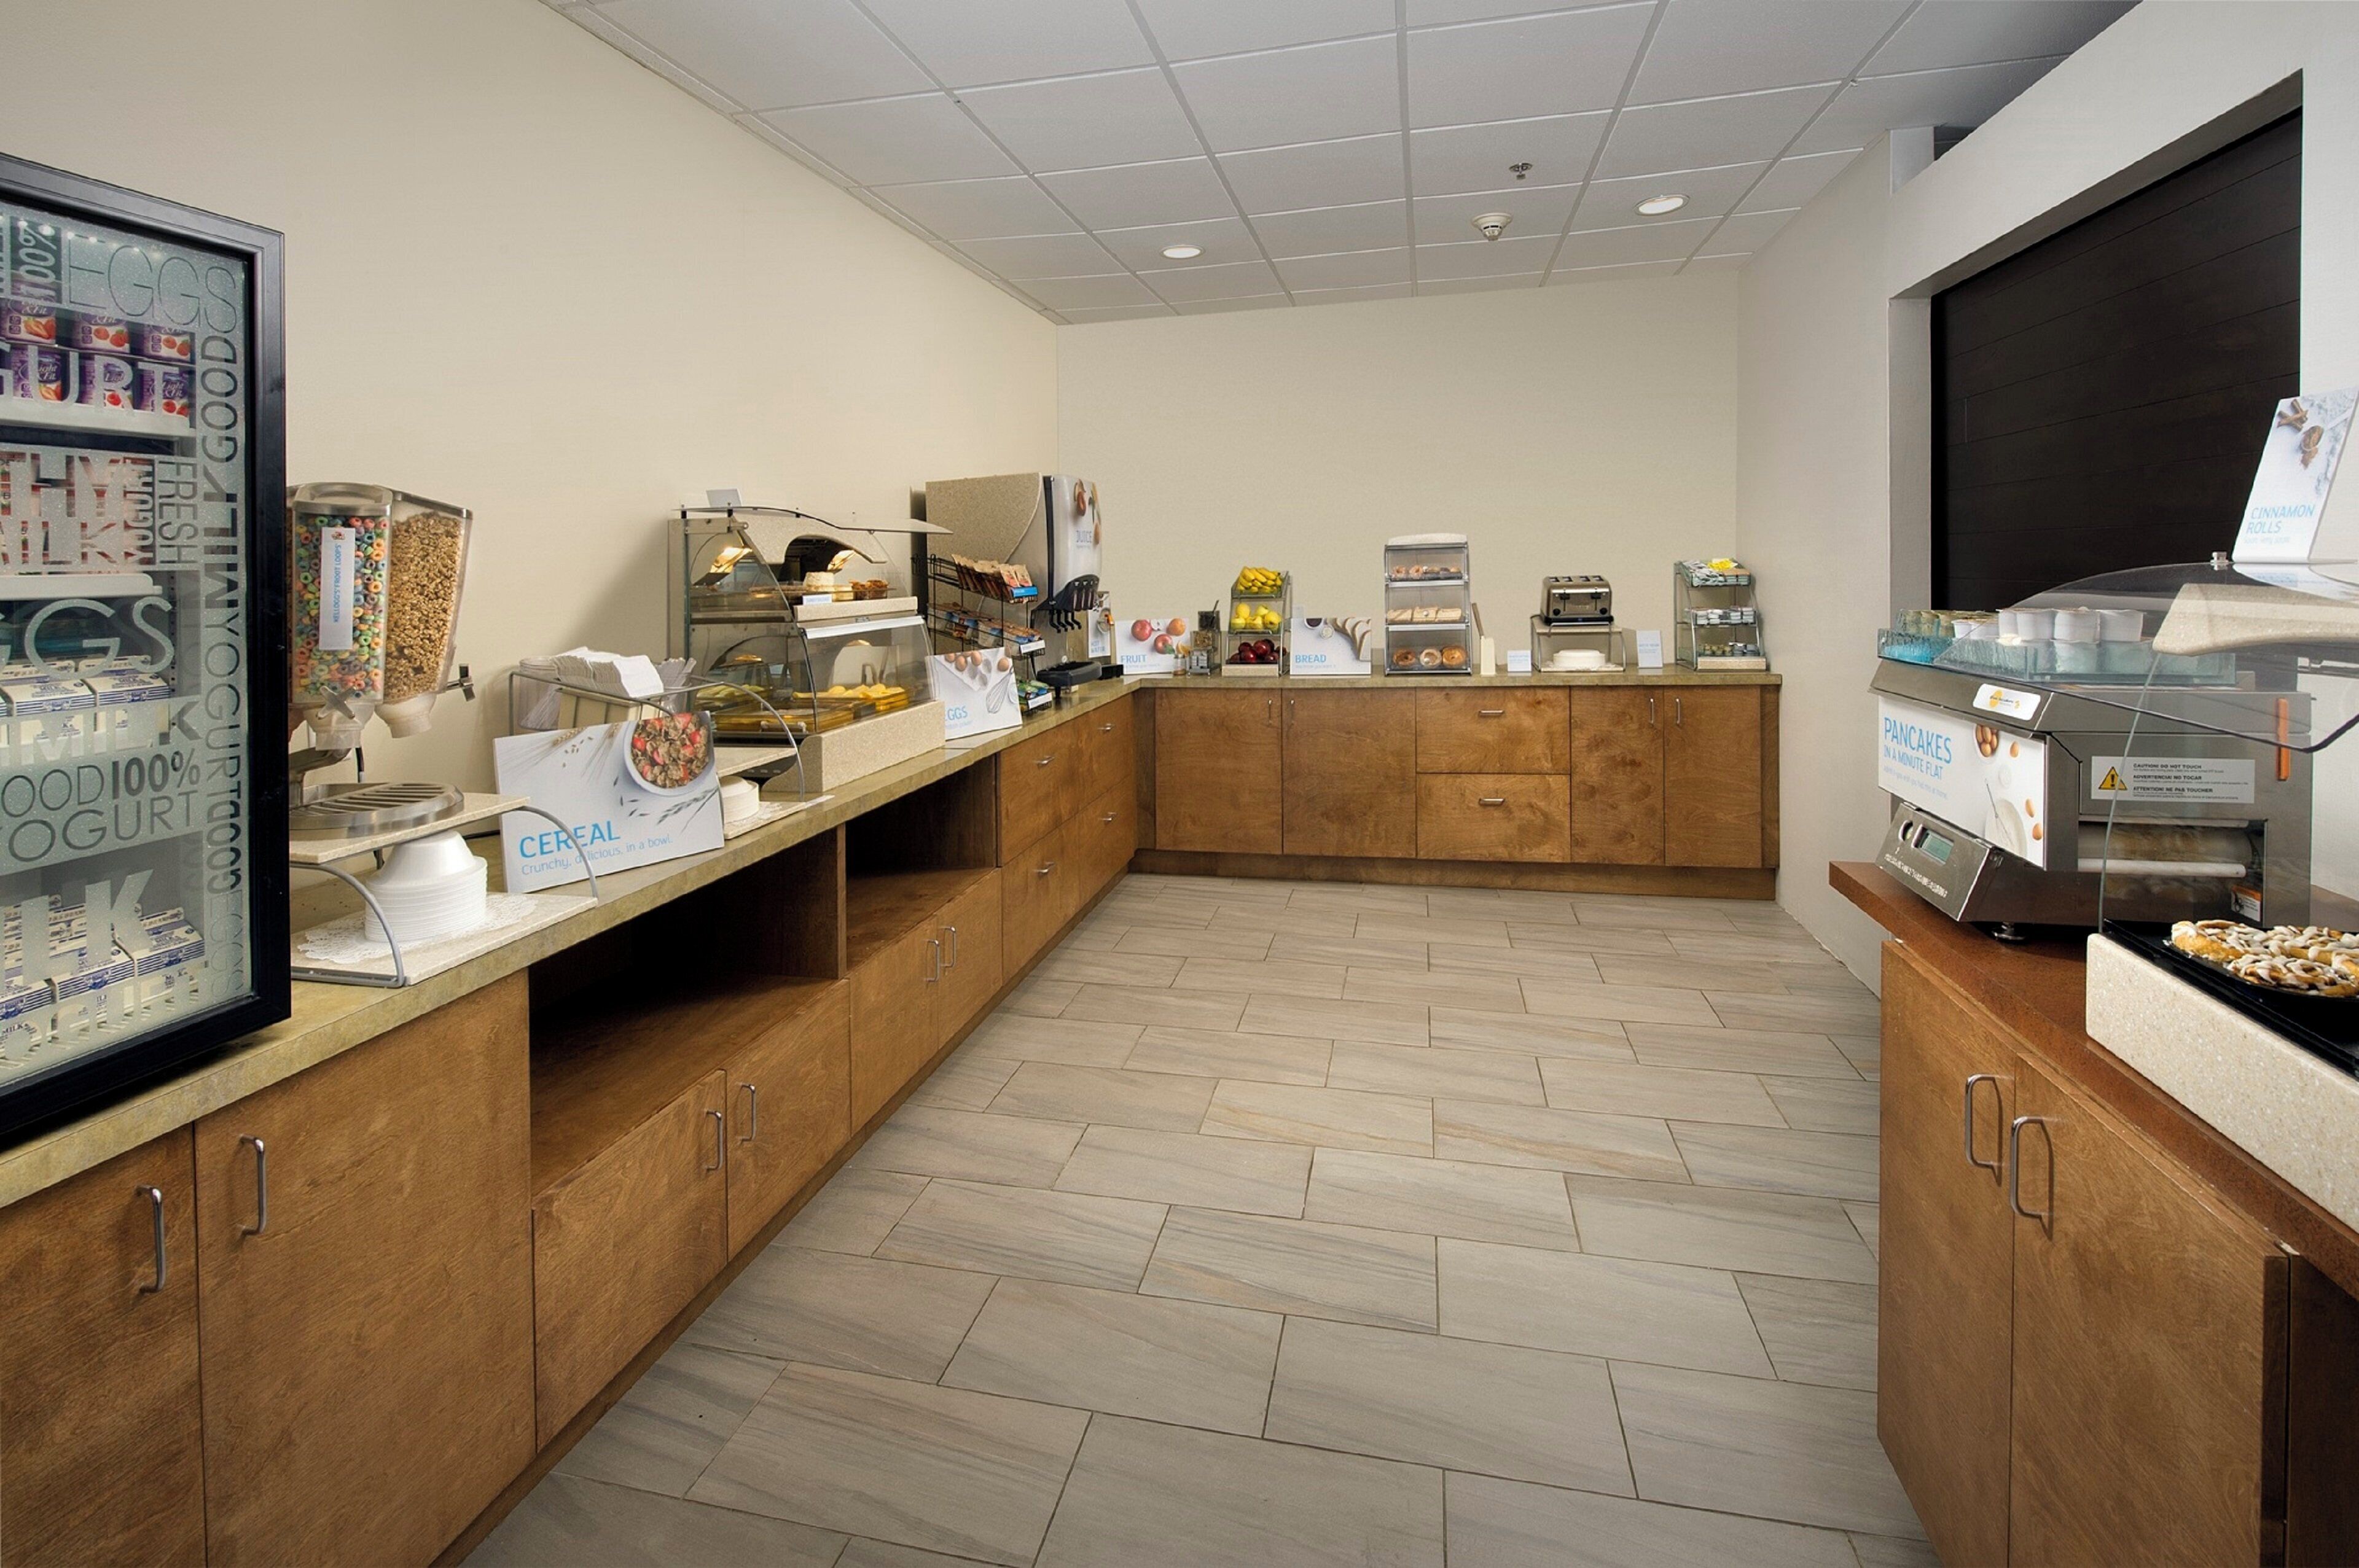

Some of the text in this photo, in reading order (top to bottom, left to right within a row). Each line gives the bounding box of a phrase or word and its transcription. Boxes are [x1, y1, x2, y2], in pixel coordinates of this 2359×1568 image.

[69, 233, 238, 333] EGGS
[201, 335, 238, 463] GOOD
[124, 456, 154, 564] YOGURT
[158, 461, 198, 564] FRESH
[203, 464, 238, 609] MILK
[2245, 520, 2282, 534] ROLLS
[2251, 504, 2315, 520] CINNAMON
[0, 596, 174, 679] GS
[1121, 655, 1146, 663] FRUIT
[1295, 655, 1327, 663] BREAD
[205, 613, 241, 800] YOGURT
[947, 705, 968, 720] GGS
[1884, 717, 1952, 764] PANCAKES
[112, 748, 200, 800] 100%
[1884, 744, 1943, 780] IN A MINUTE FLAT
[0, 790, 198, 862] OGURT
[206, 800, 242, 894] GOOD
[520, 821, 620, 858] CEREAL
[522, 856, 572, 875] Crunchy,
[575, 846, 623, 864] dlicious,
[626, 842, 636, 852] in
[648, 833, 673, 849] bowl.
[0, 868, 154, 985] LK
[210, 889, 244, 997] EGGS
